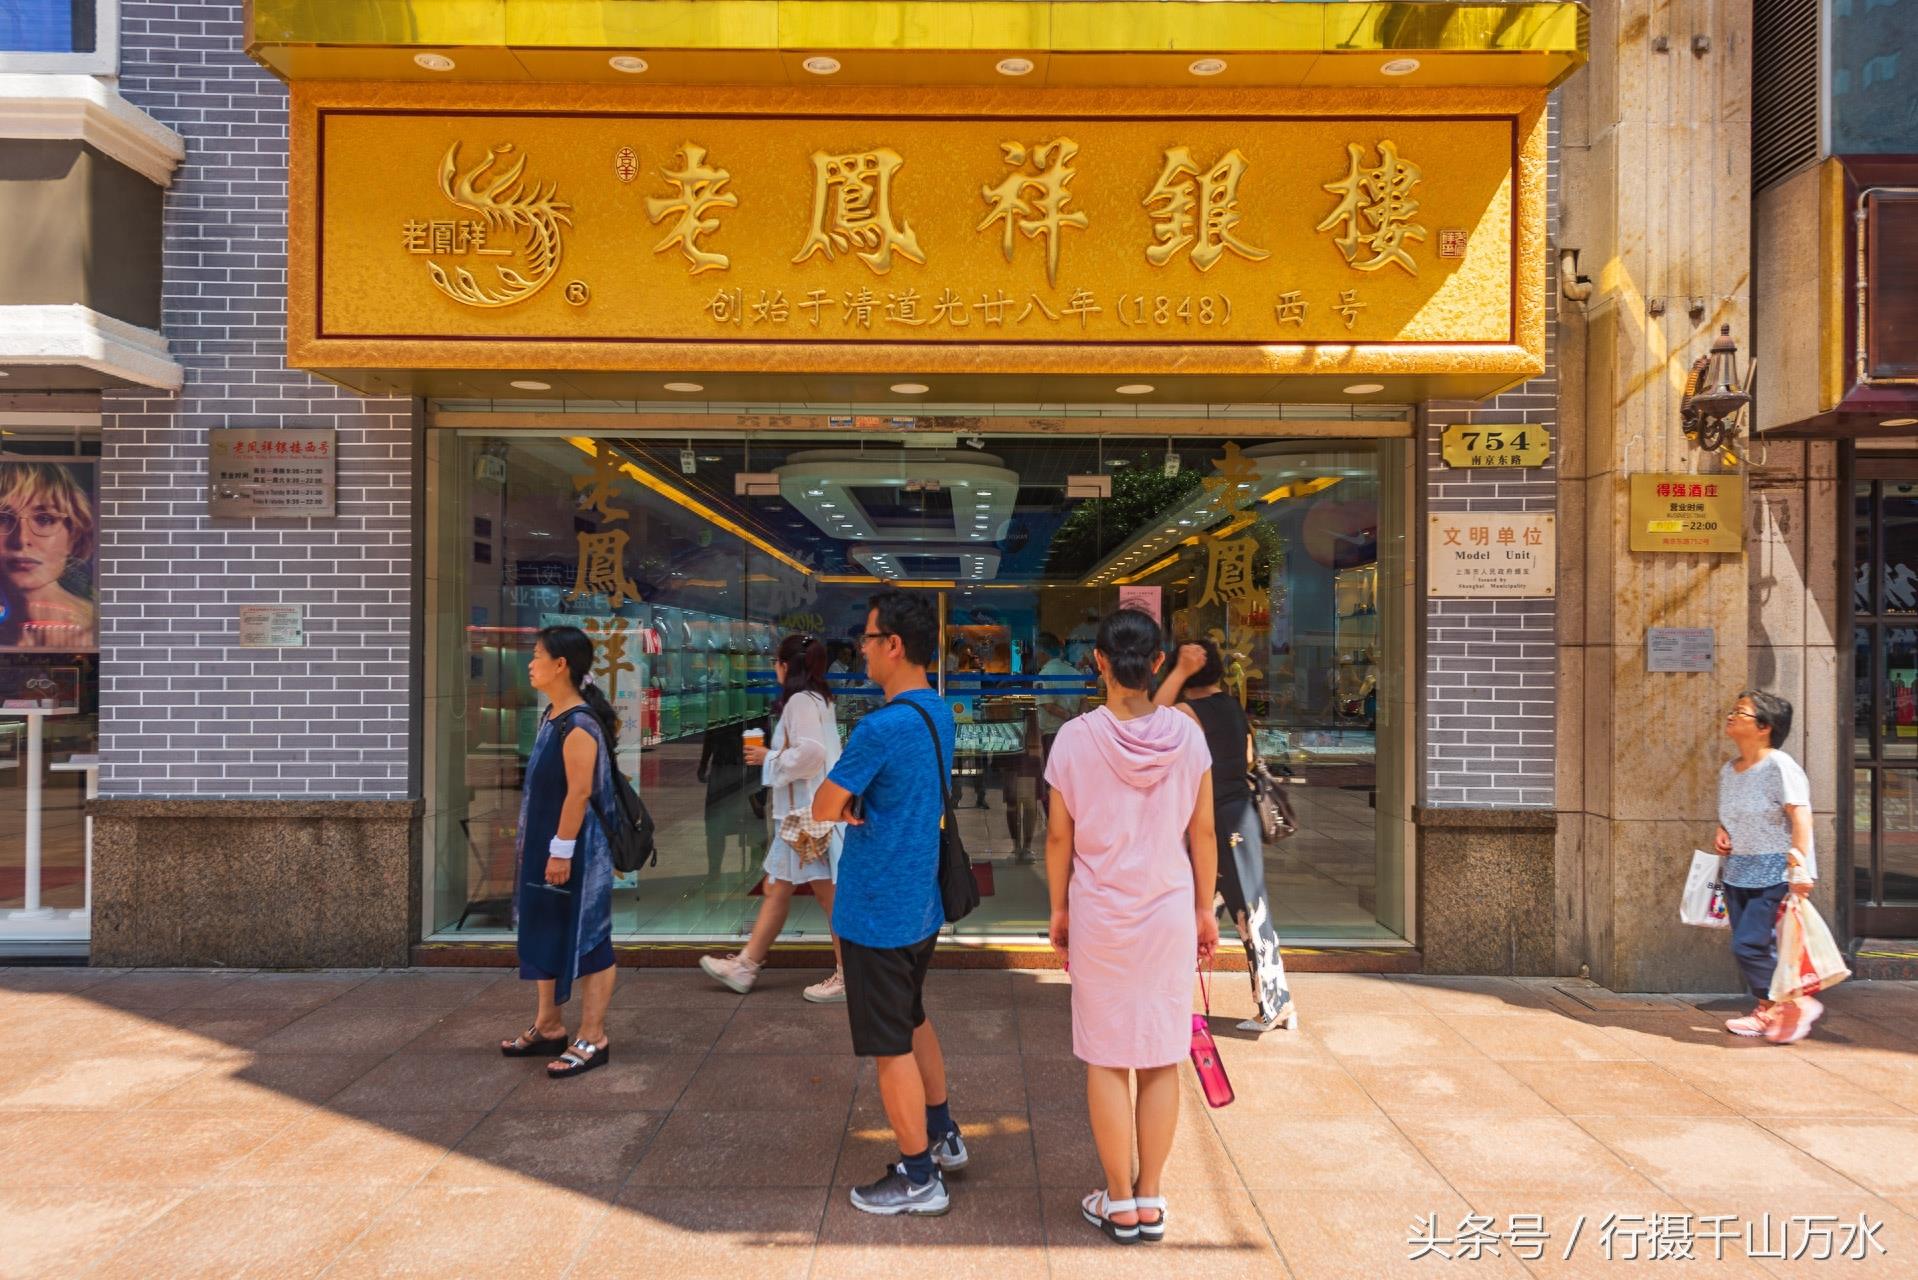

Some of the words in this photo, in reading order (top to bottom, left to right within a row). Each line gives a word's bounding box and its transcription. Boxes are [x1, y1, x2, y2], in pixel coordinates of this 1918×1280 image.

[645, 136, 1427, 288] 老鳳祥銀樓
[1274, 290, 1368, 329] 西号
[1461, 431, 1530, 451] 754
[1471, 455, 1522, 465] 南京东路
[1443, 526, 1543, 546] 文明单位
[1455, 551, 1490, 560] Model
[1505, 551, 1531, 560] Unit
